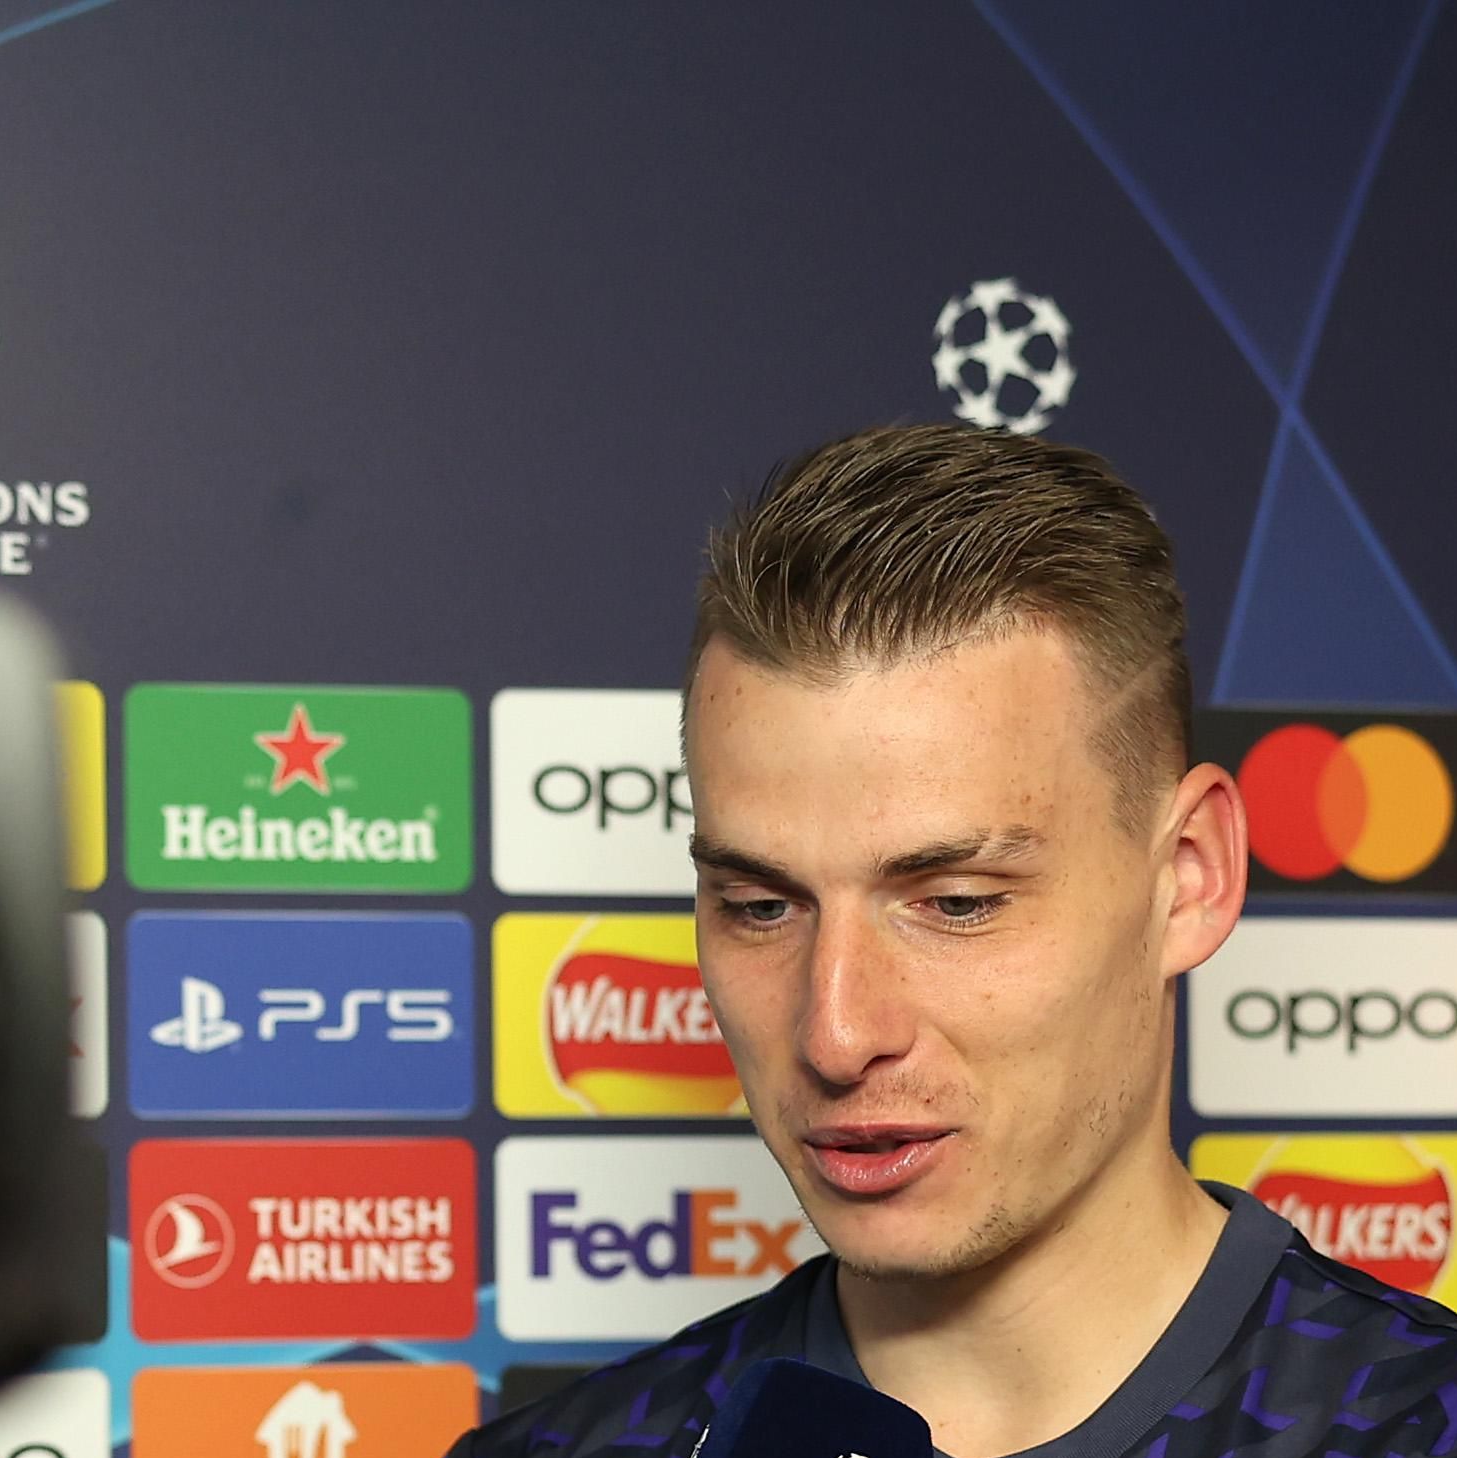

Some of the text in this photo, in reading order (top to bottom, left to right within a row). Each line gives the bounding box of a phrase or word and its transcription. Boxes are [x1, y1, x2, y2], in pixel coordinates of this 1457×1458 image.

[533, 764, 694, 831] opp
[161, 804, 438, 862] Heineken
[258, 988, 454, 1042] PS5
[551, 975, 726, 1043] WALKE
[249, 1196, 451, 1239] TURKISH
[530, 1190, 801, 1279] FedEx
[248, 1241, 454, 1283] AIRLINES
